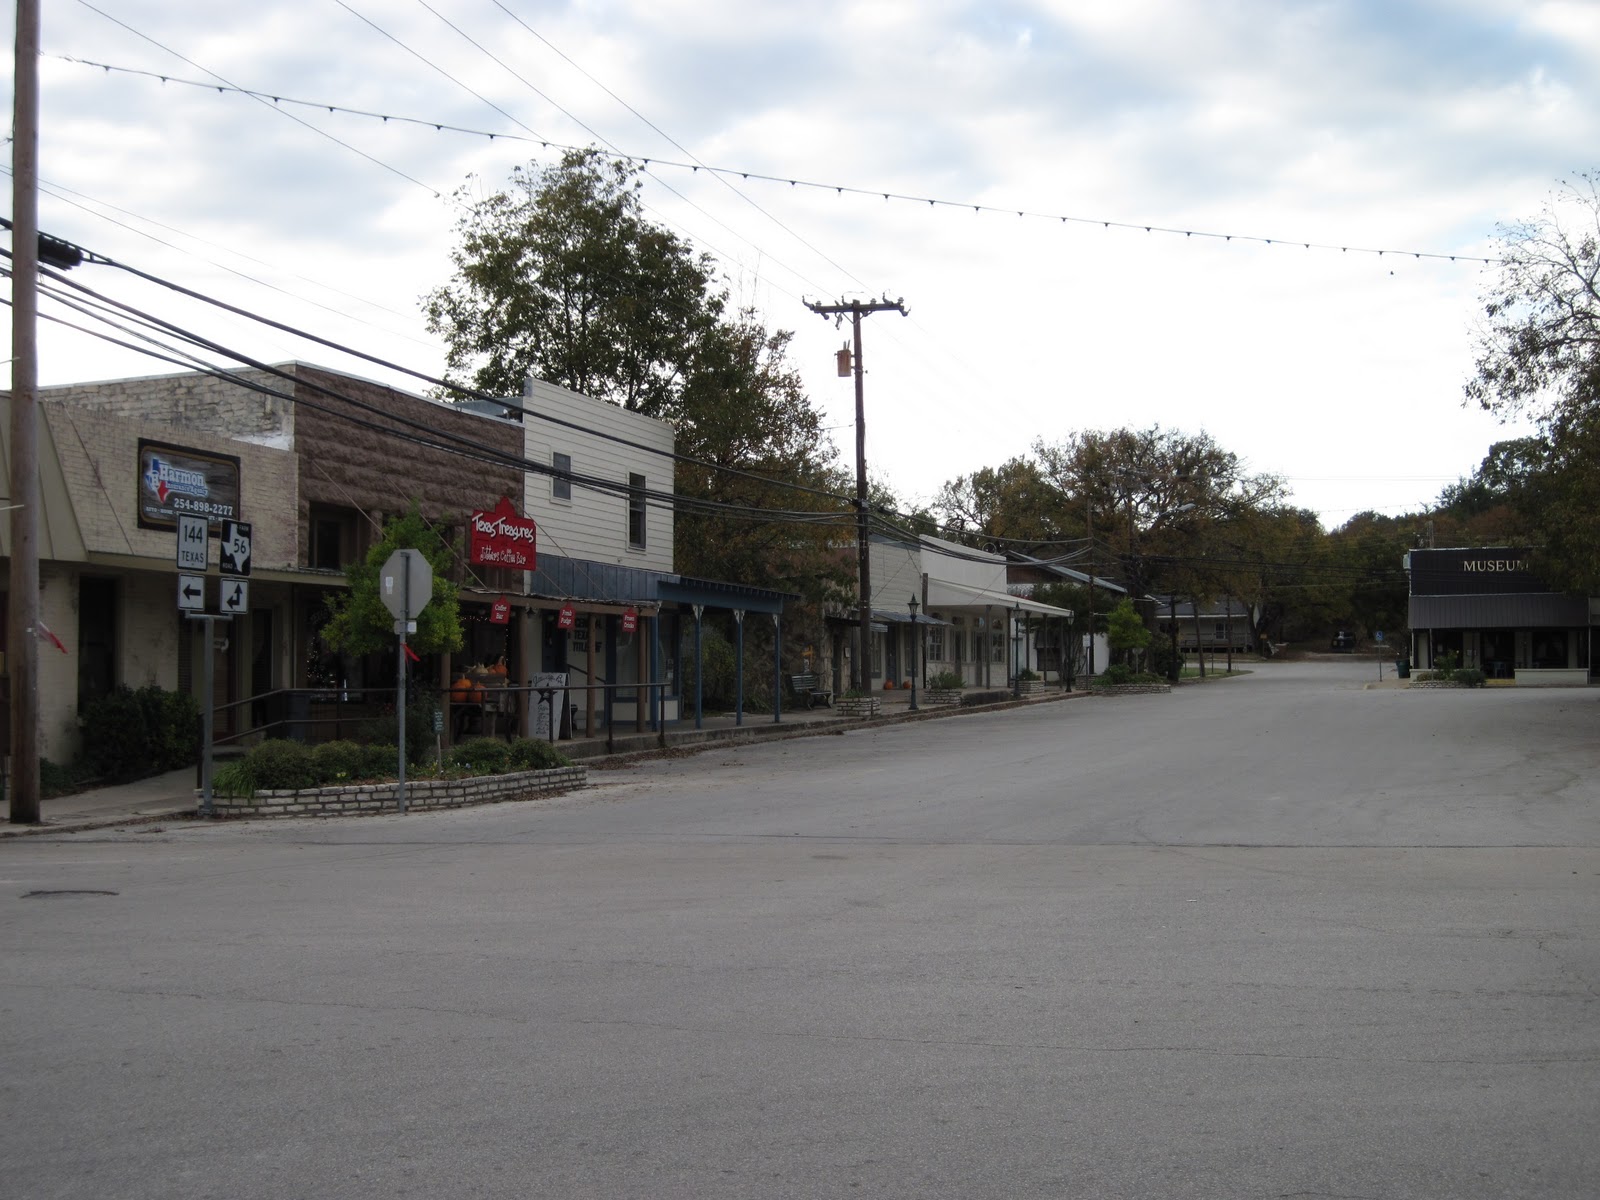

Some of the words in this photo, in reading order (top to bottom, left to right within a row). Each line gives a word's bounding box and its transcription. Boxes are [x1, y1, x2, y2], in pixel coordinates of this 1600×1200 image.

[159, 464, 204, 487] Harmon
[174, 498, 233, 516] 254-898-2277
[184, 525, 203, 544] 144
[471, 512, 496, 537] Texas
[494, 516, 534, 543] Treasures
[234, 539, 247, 554] 56
[181, 550, 204, 564] TEXAS
[222, 562, 233, 570] ROAD
[494, 604, 507, 612] Coffee
